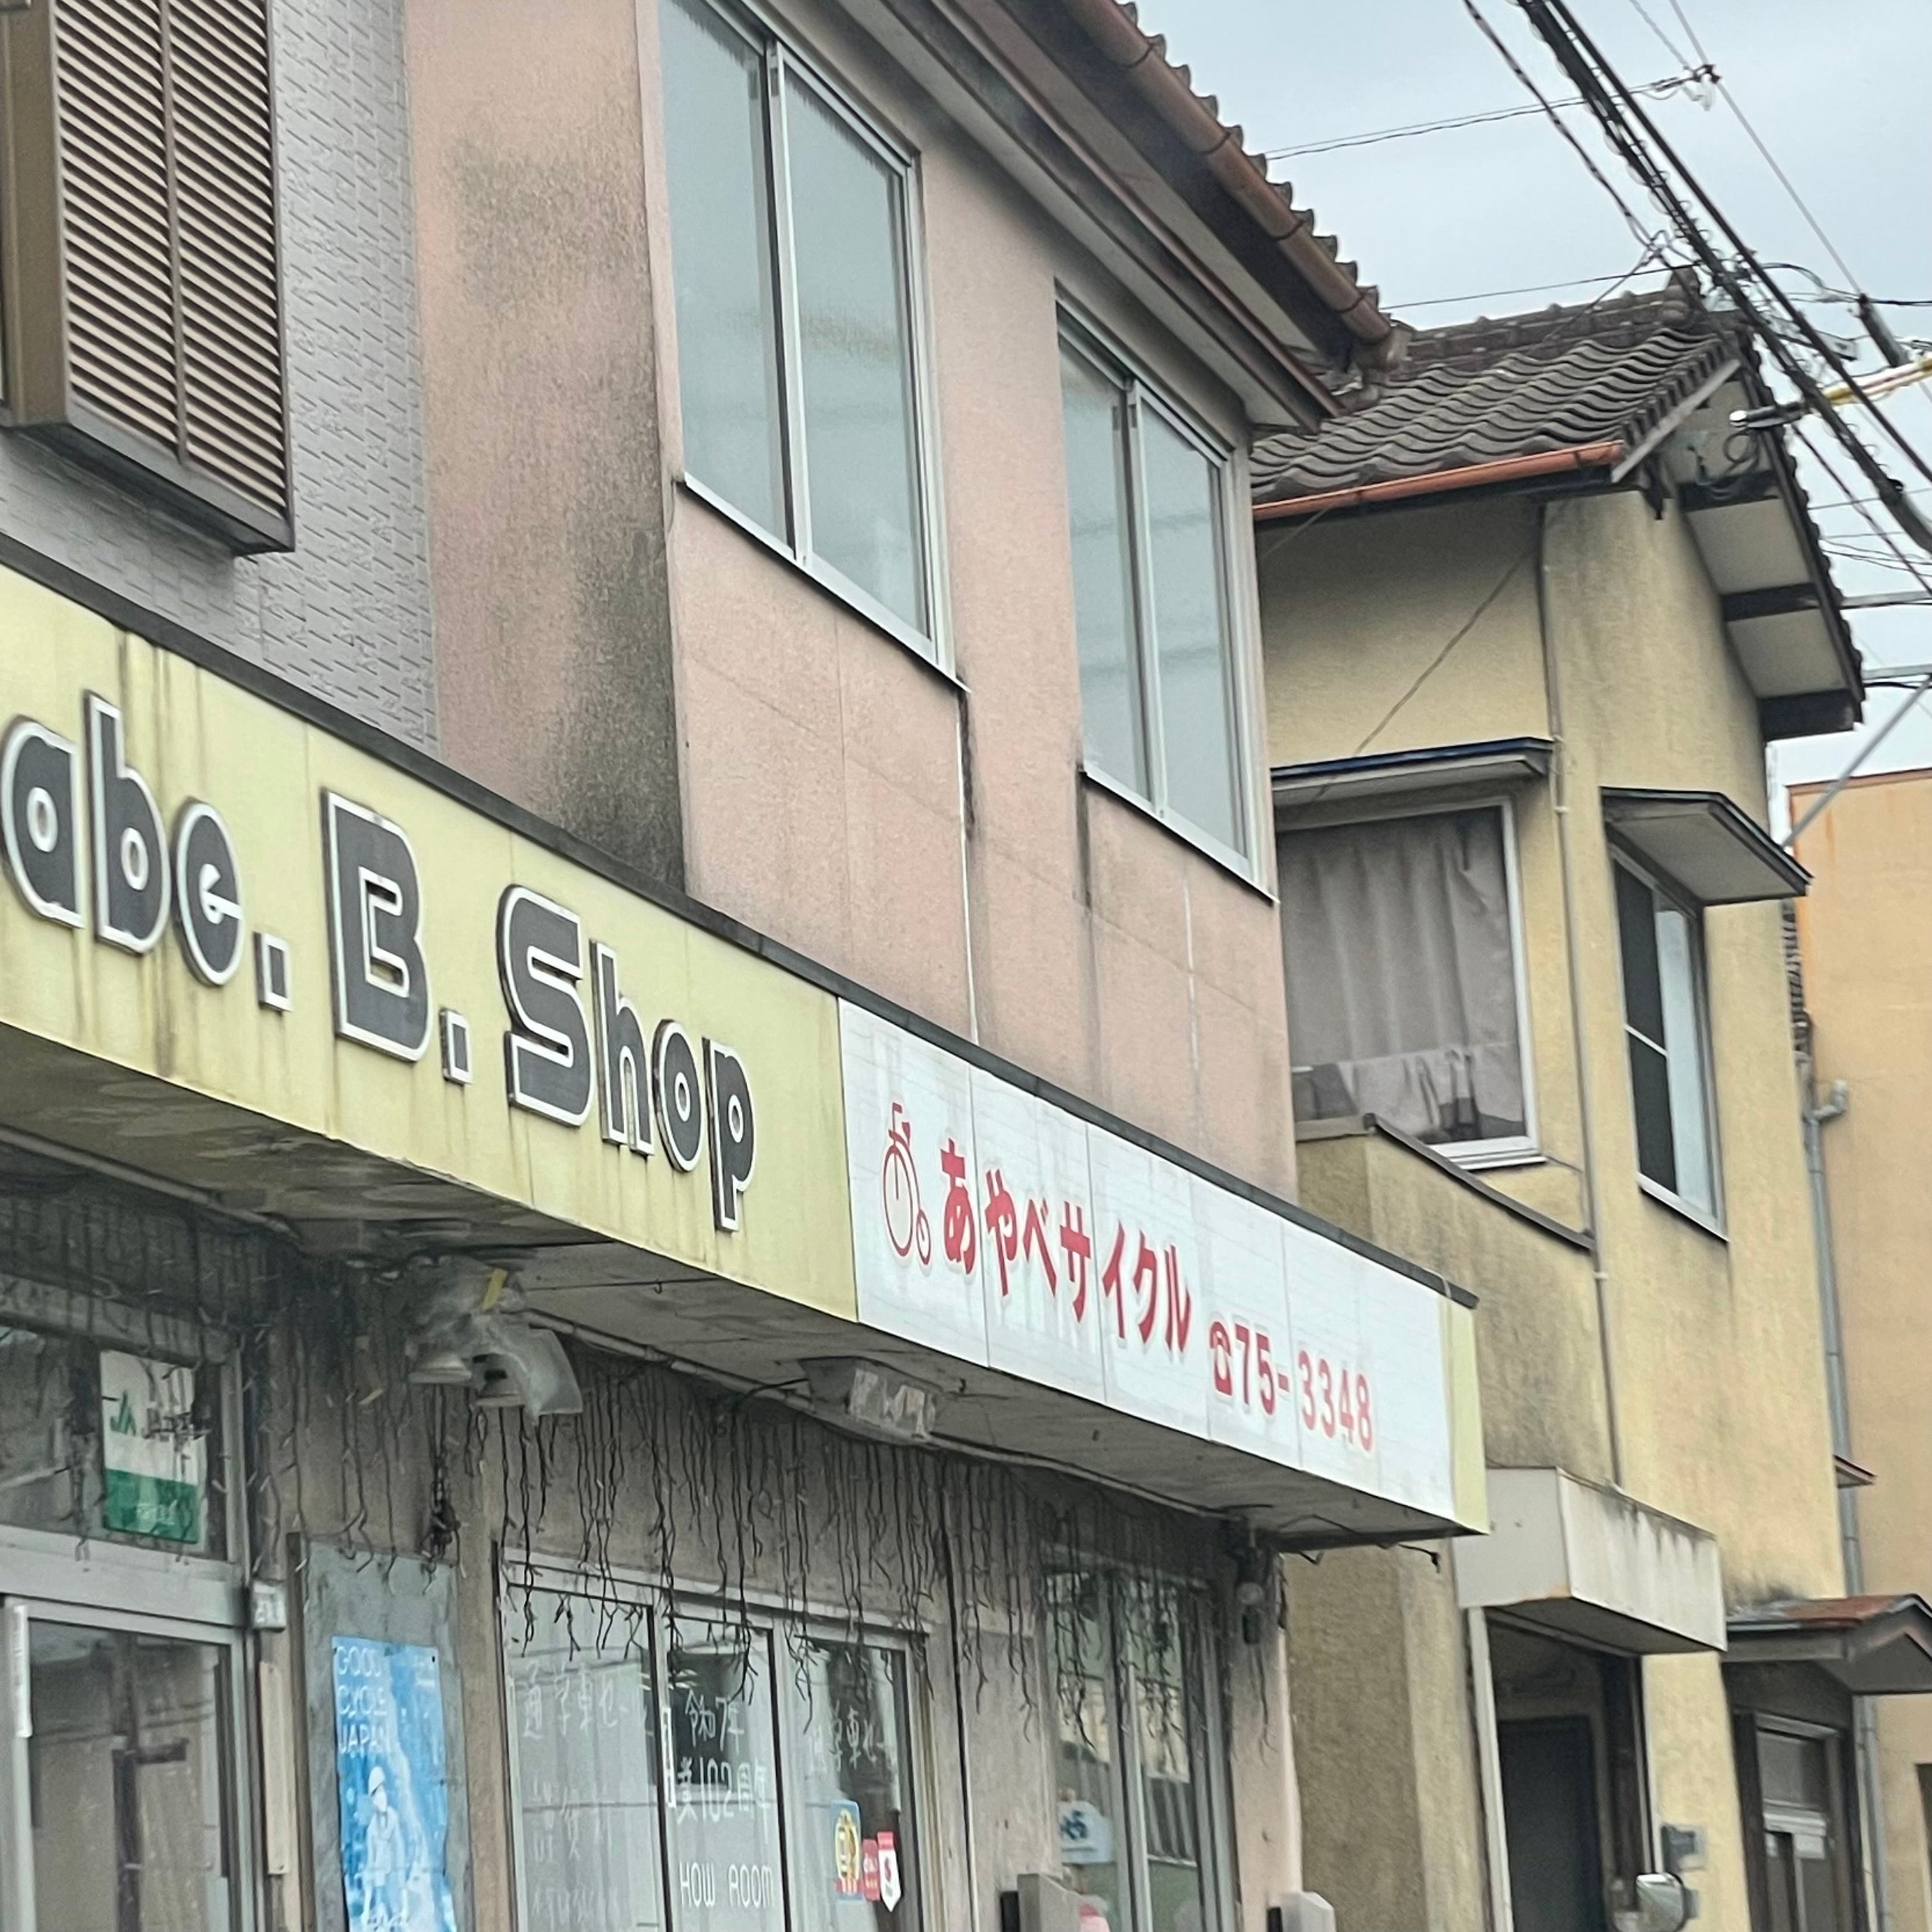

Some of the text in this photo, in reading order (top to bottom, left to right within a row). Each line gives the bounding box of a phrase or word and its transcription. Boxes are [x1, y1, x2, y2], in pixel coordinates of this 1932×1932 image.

[496, 882, 756, 1232] Shop
[940, 1137, 1191, 1353] あやべサイクル
[1234, 1322, 1374, 1452] 75-3348
[336, 1646, 381, 1676] GOOD
[337, 1685, 387, 1719] CYCLE
[338, 1724, 391, 1758] JAPAN
